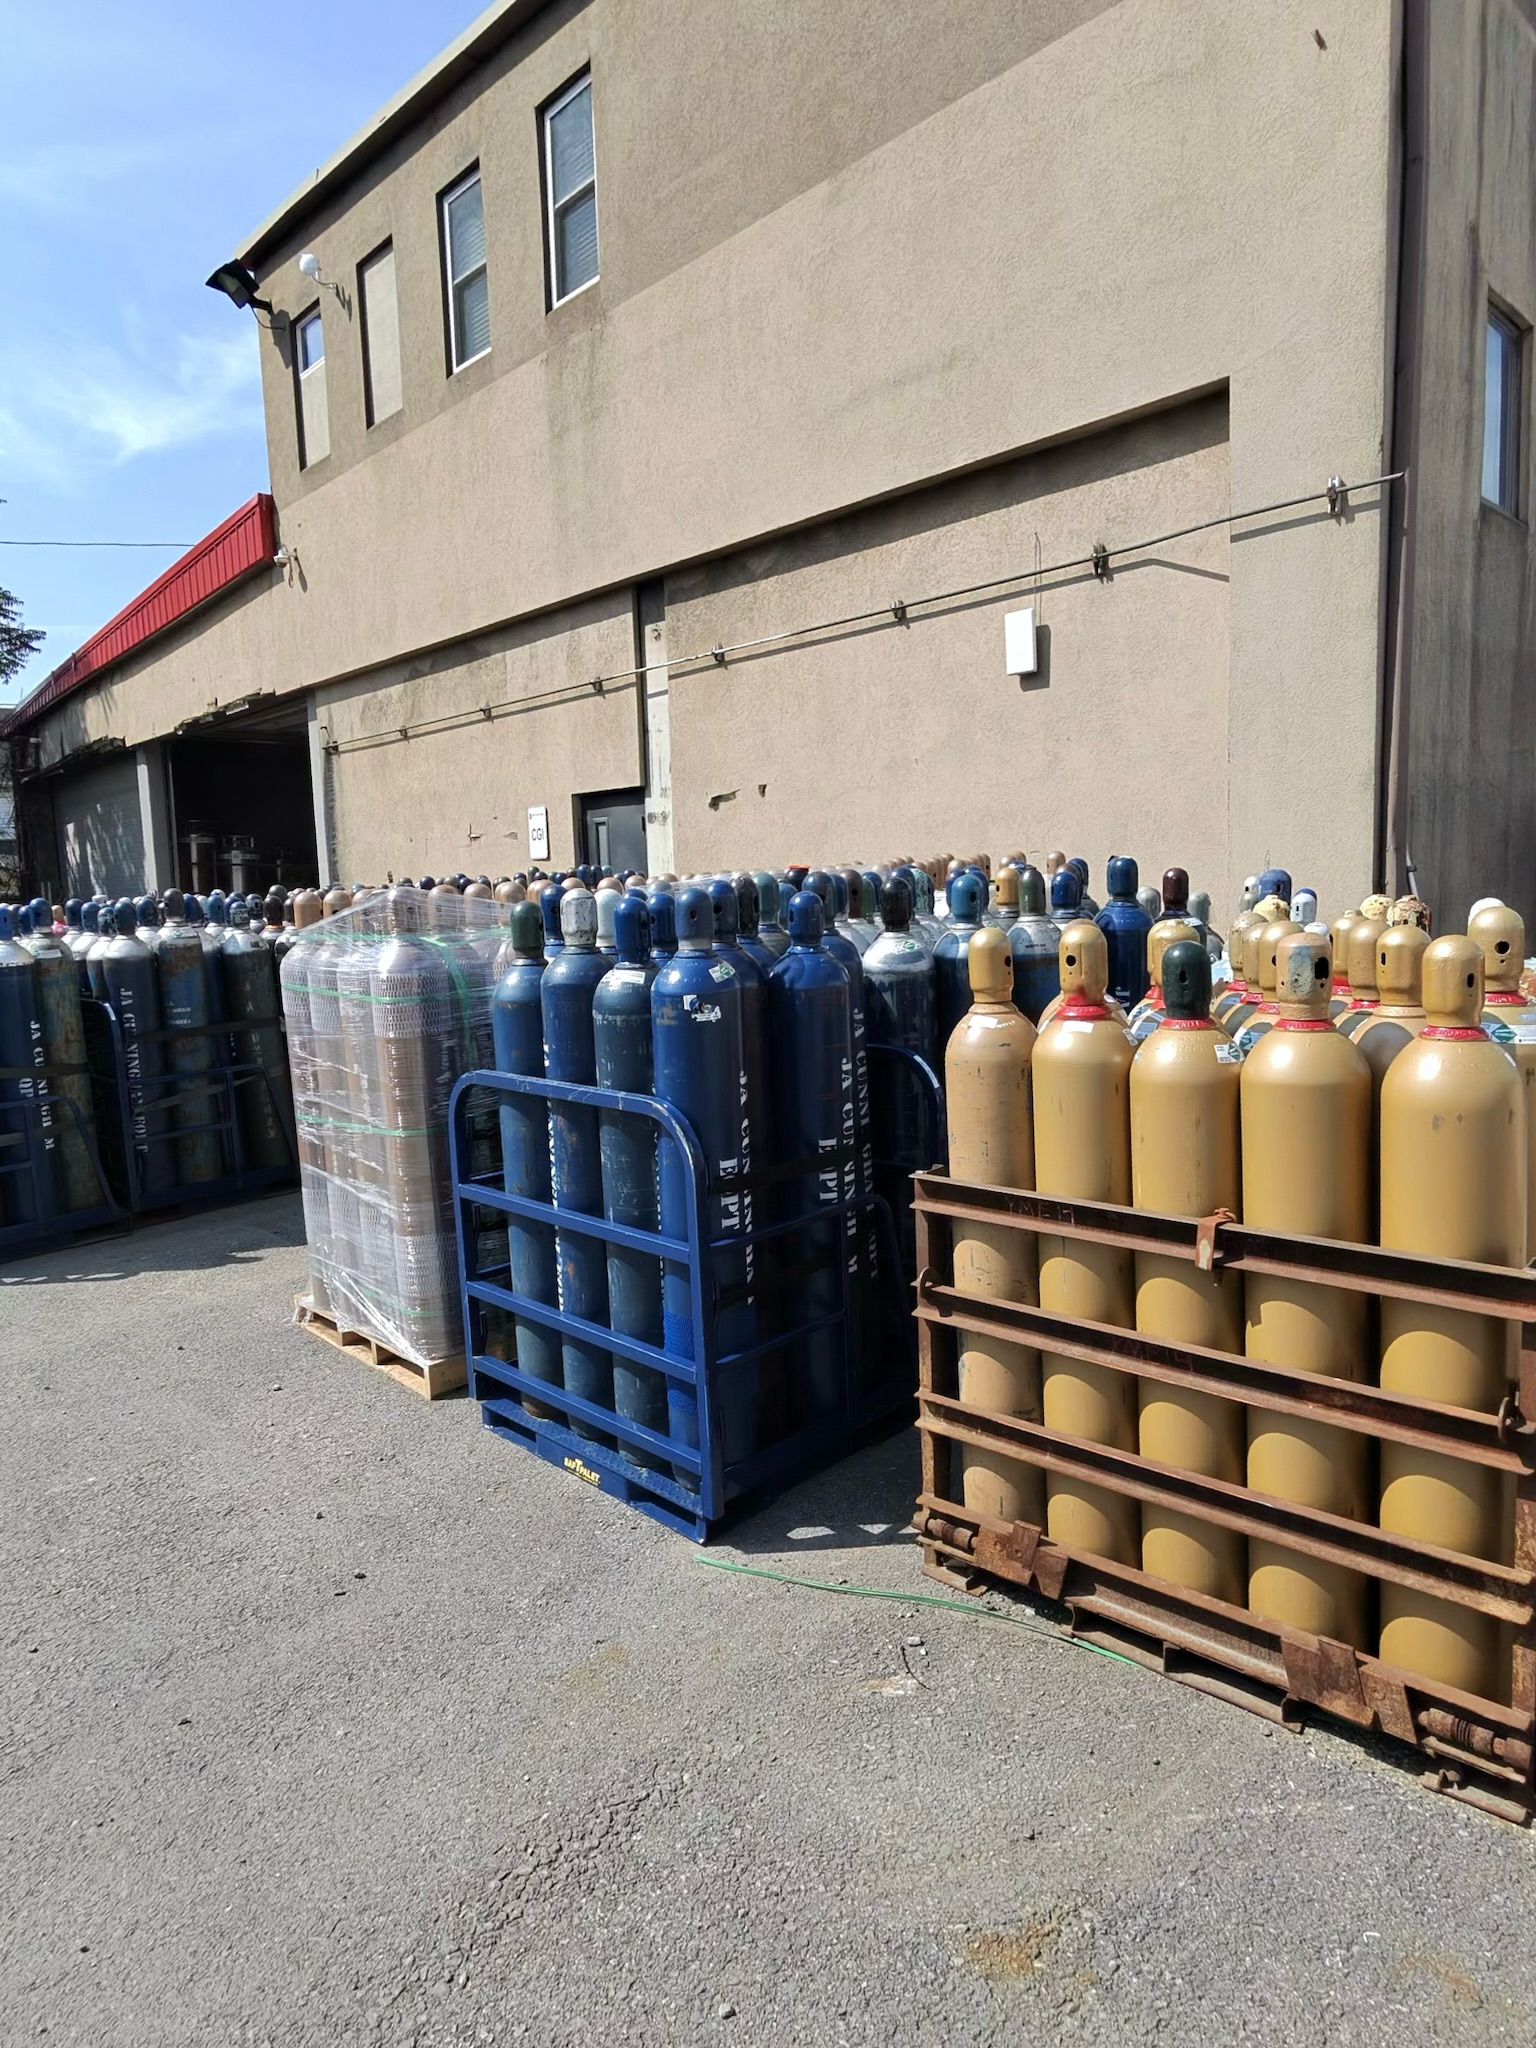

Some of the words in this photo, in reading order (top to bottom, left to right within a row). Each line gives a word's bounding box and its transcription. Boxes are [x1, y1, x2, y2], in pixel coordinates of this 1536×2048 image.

[532, 828, 544, 841] CGI
[30, 1021, 41, 1040] JA
[853, 1008, 865, 1038] JA
[740, 1070, 748, 1106] JA
[841, 1057, 853, 1090] JA
[719, 1157, 740, 1230] EPT
